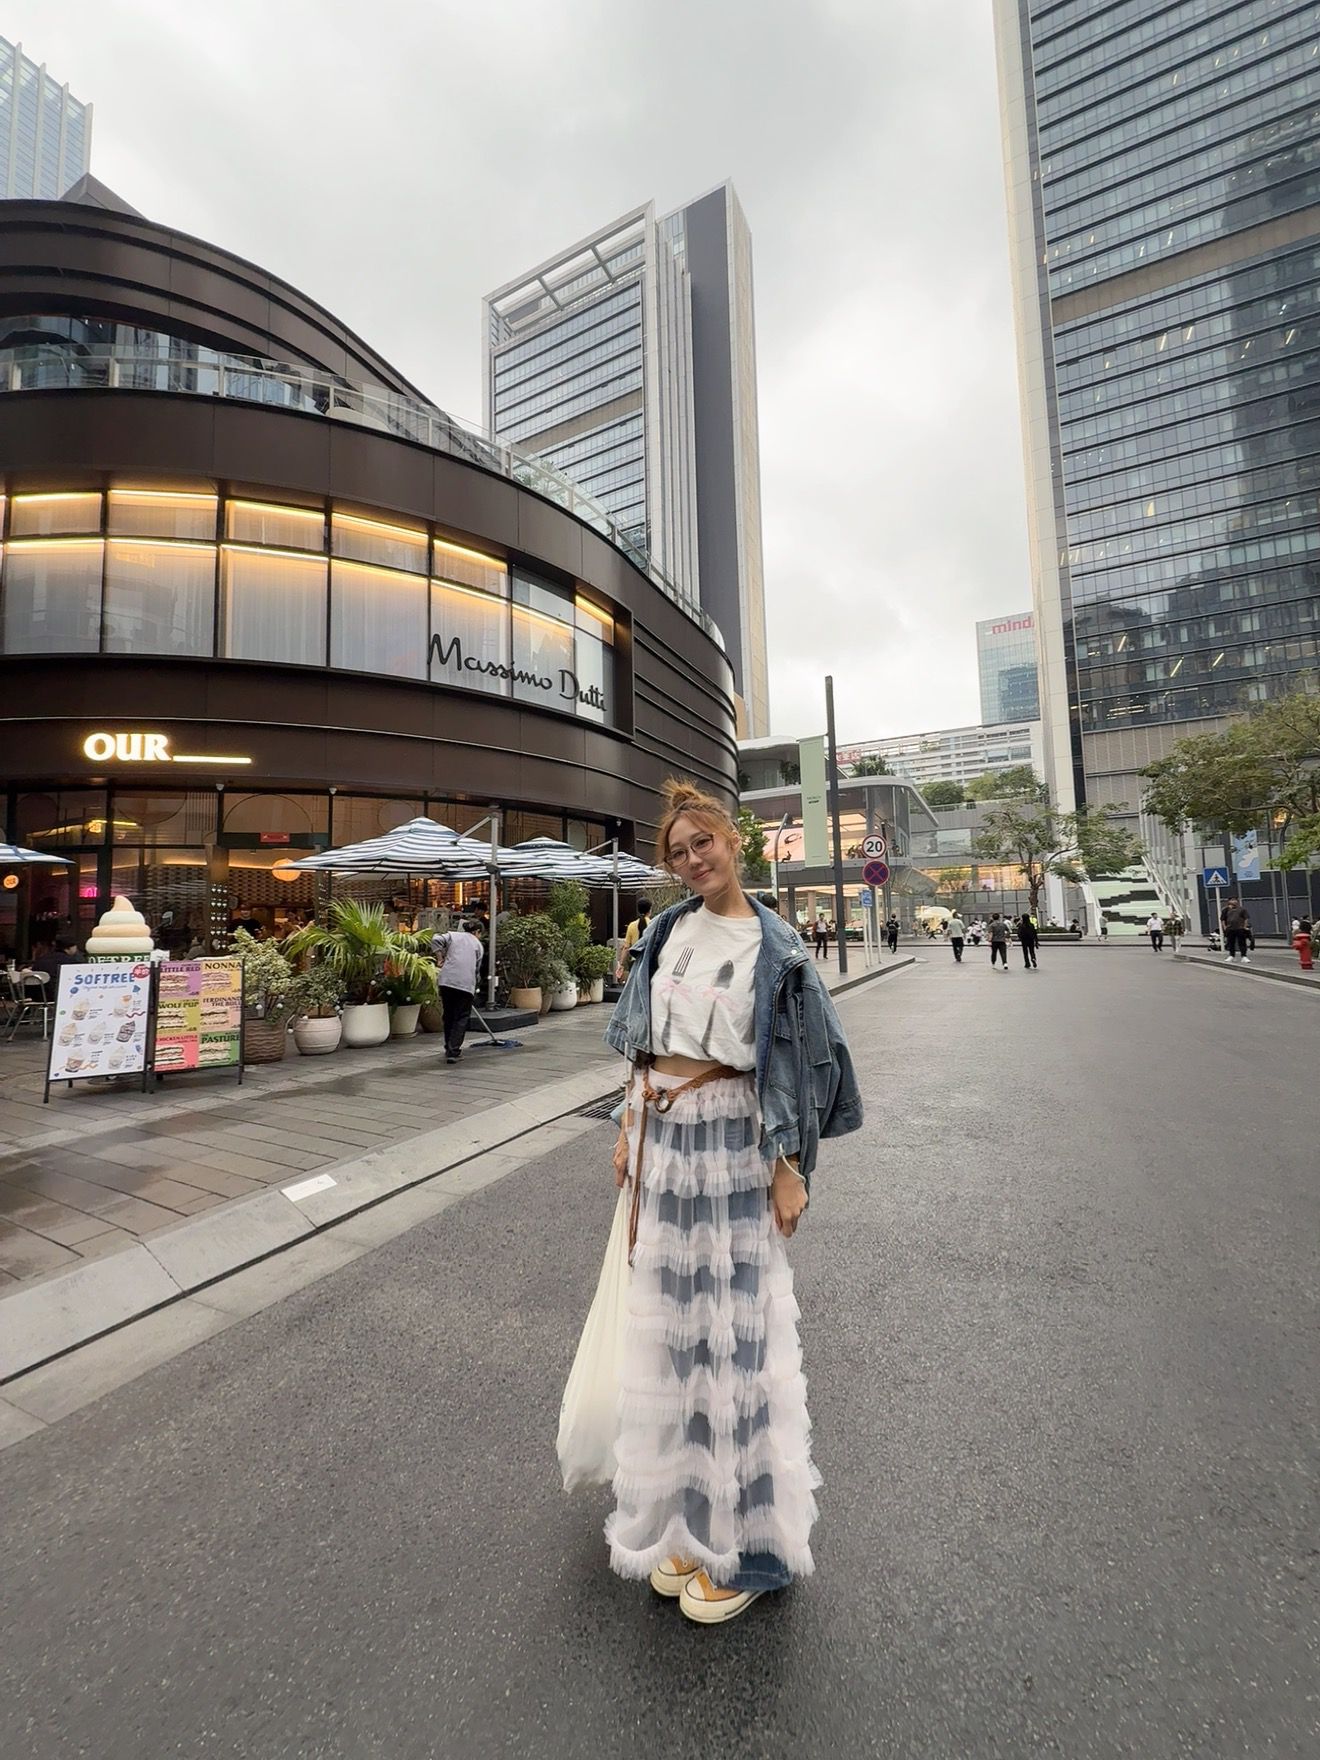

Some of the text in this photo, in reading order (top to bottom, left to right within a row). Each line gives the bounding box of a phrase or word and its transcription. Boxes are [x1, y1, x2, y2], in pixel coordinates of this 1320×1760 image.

[428, 634, 607, 711] Massimo Dutti
[866, 841, 883, 853] 20
[205, 962, 241, 970] NONNA
[74, 973, 135, 985] SOFTREE
